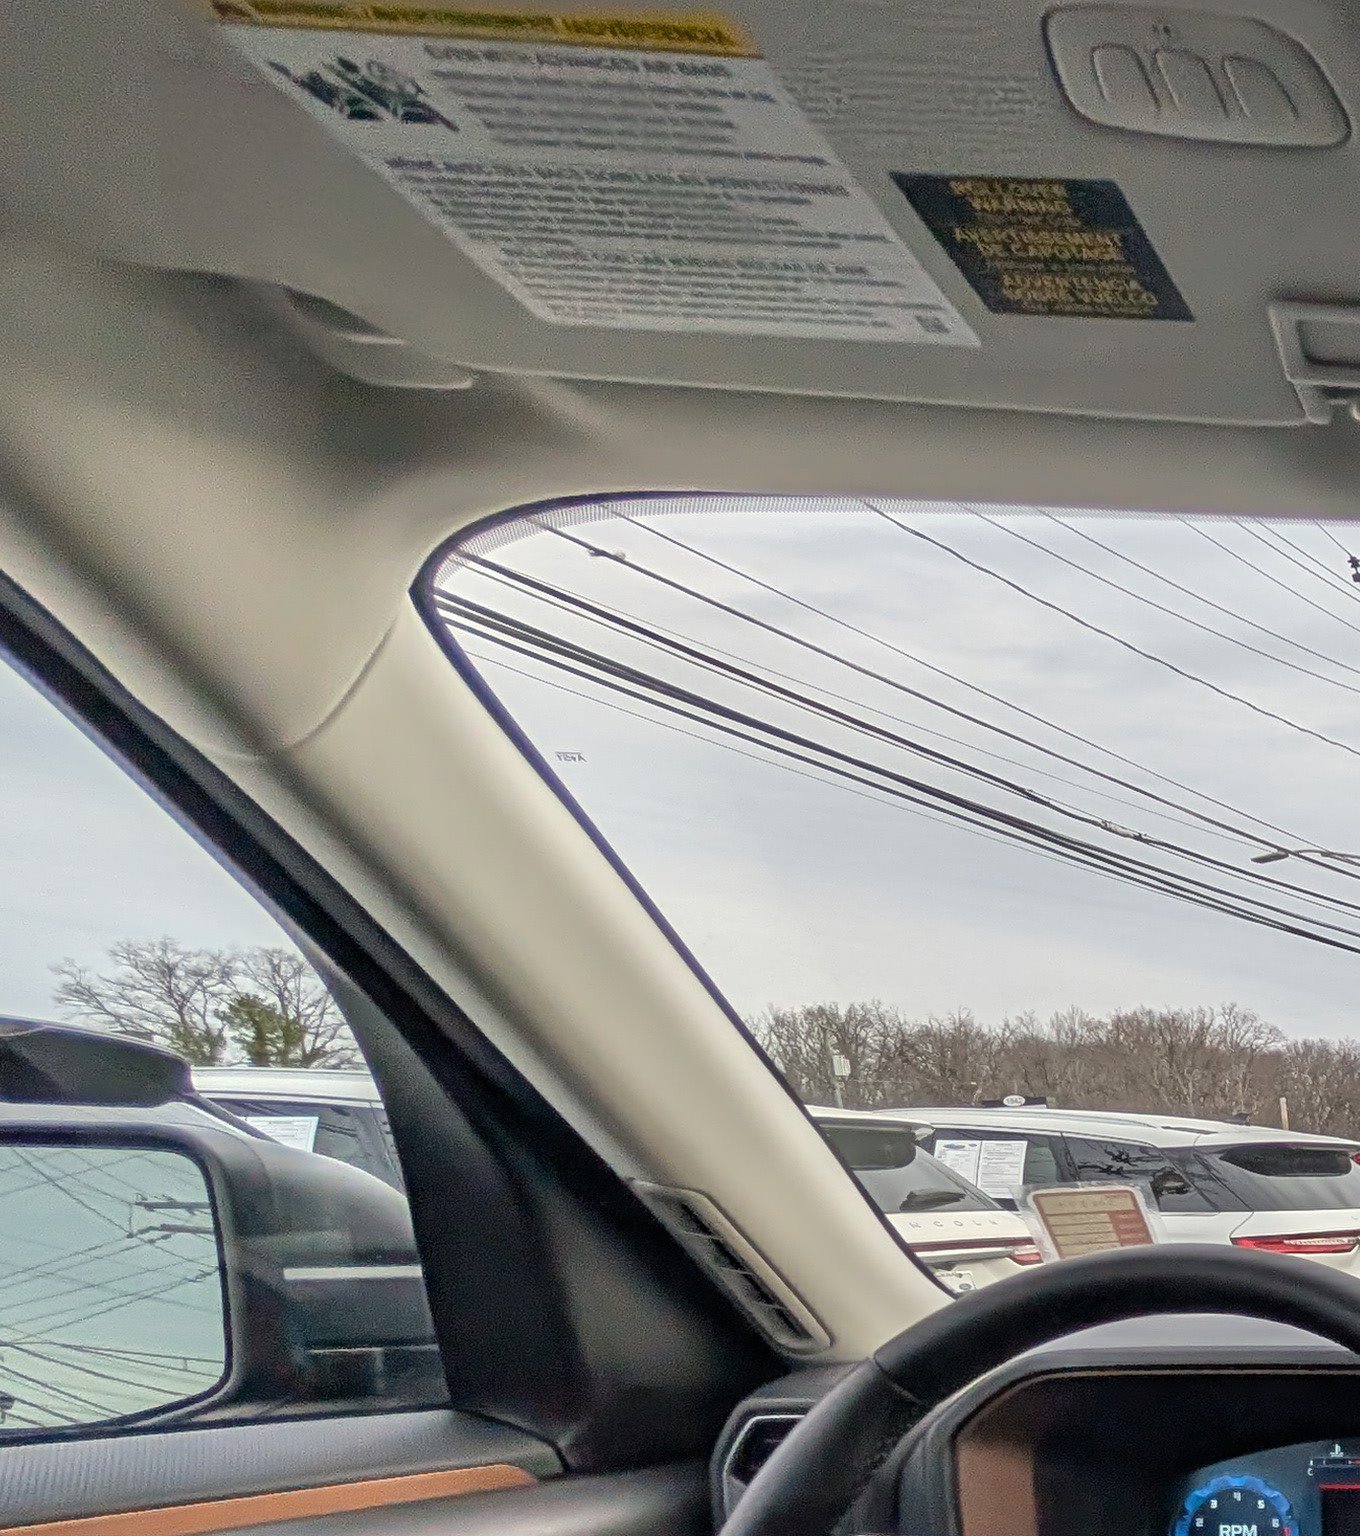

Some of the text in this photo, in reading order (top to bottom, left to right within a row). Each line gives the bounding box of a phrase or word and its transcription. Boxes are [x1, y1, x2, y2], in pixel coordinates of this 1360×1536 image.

[1307, 1467, 1313, 1476] C
[1233, 1492, 1241, 1501] 4
[1210, 1500, 1218, 1509] 3
[1257, 1500, 1265, 1509] 5
[1196, 1518, 1204, 1528] 2
